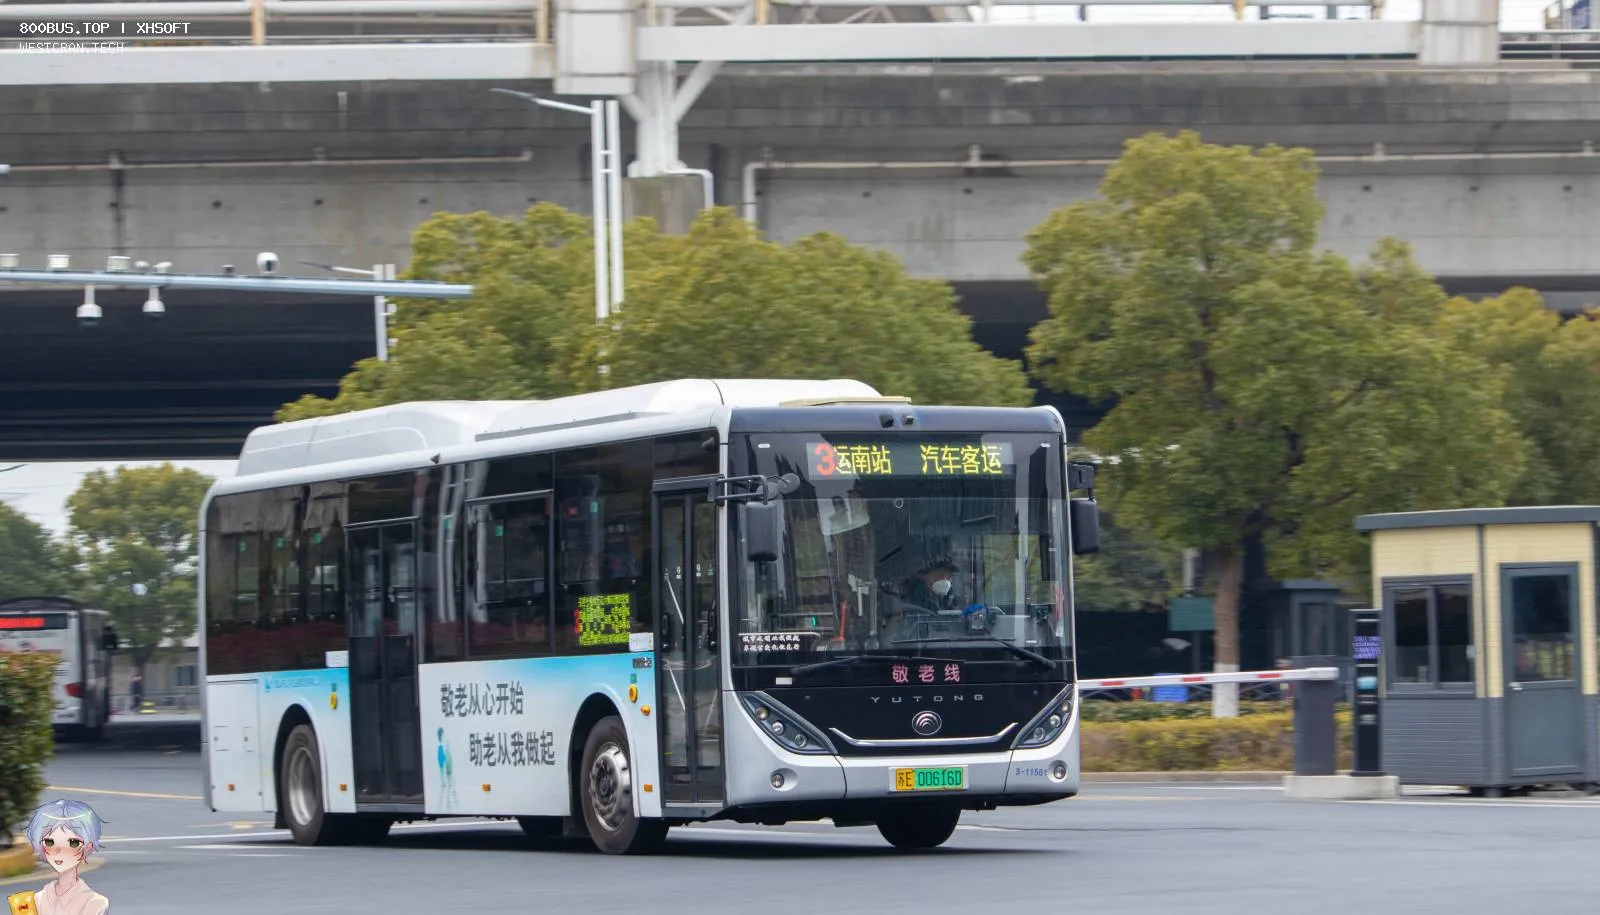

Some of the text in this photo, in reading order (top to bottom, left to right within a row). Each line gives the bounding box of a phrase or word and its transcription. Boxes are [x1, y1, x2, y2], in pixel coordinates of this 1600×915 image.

[815, 443, 834, 476] 3
[920, 445, 1003, 474] 汽车客运
[892, 664, 960, 683] 敬老线
[440, 681, 524, 718] 敬老从心开始
[871, 695, 984, 703] YUTONG
[469, 731, 555, 767] 助老从我做起
[918, 771, 963, 787] 00616D
